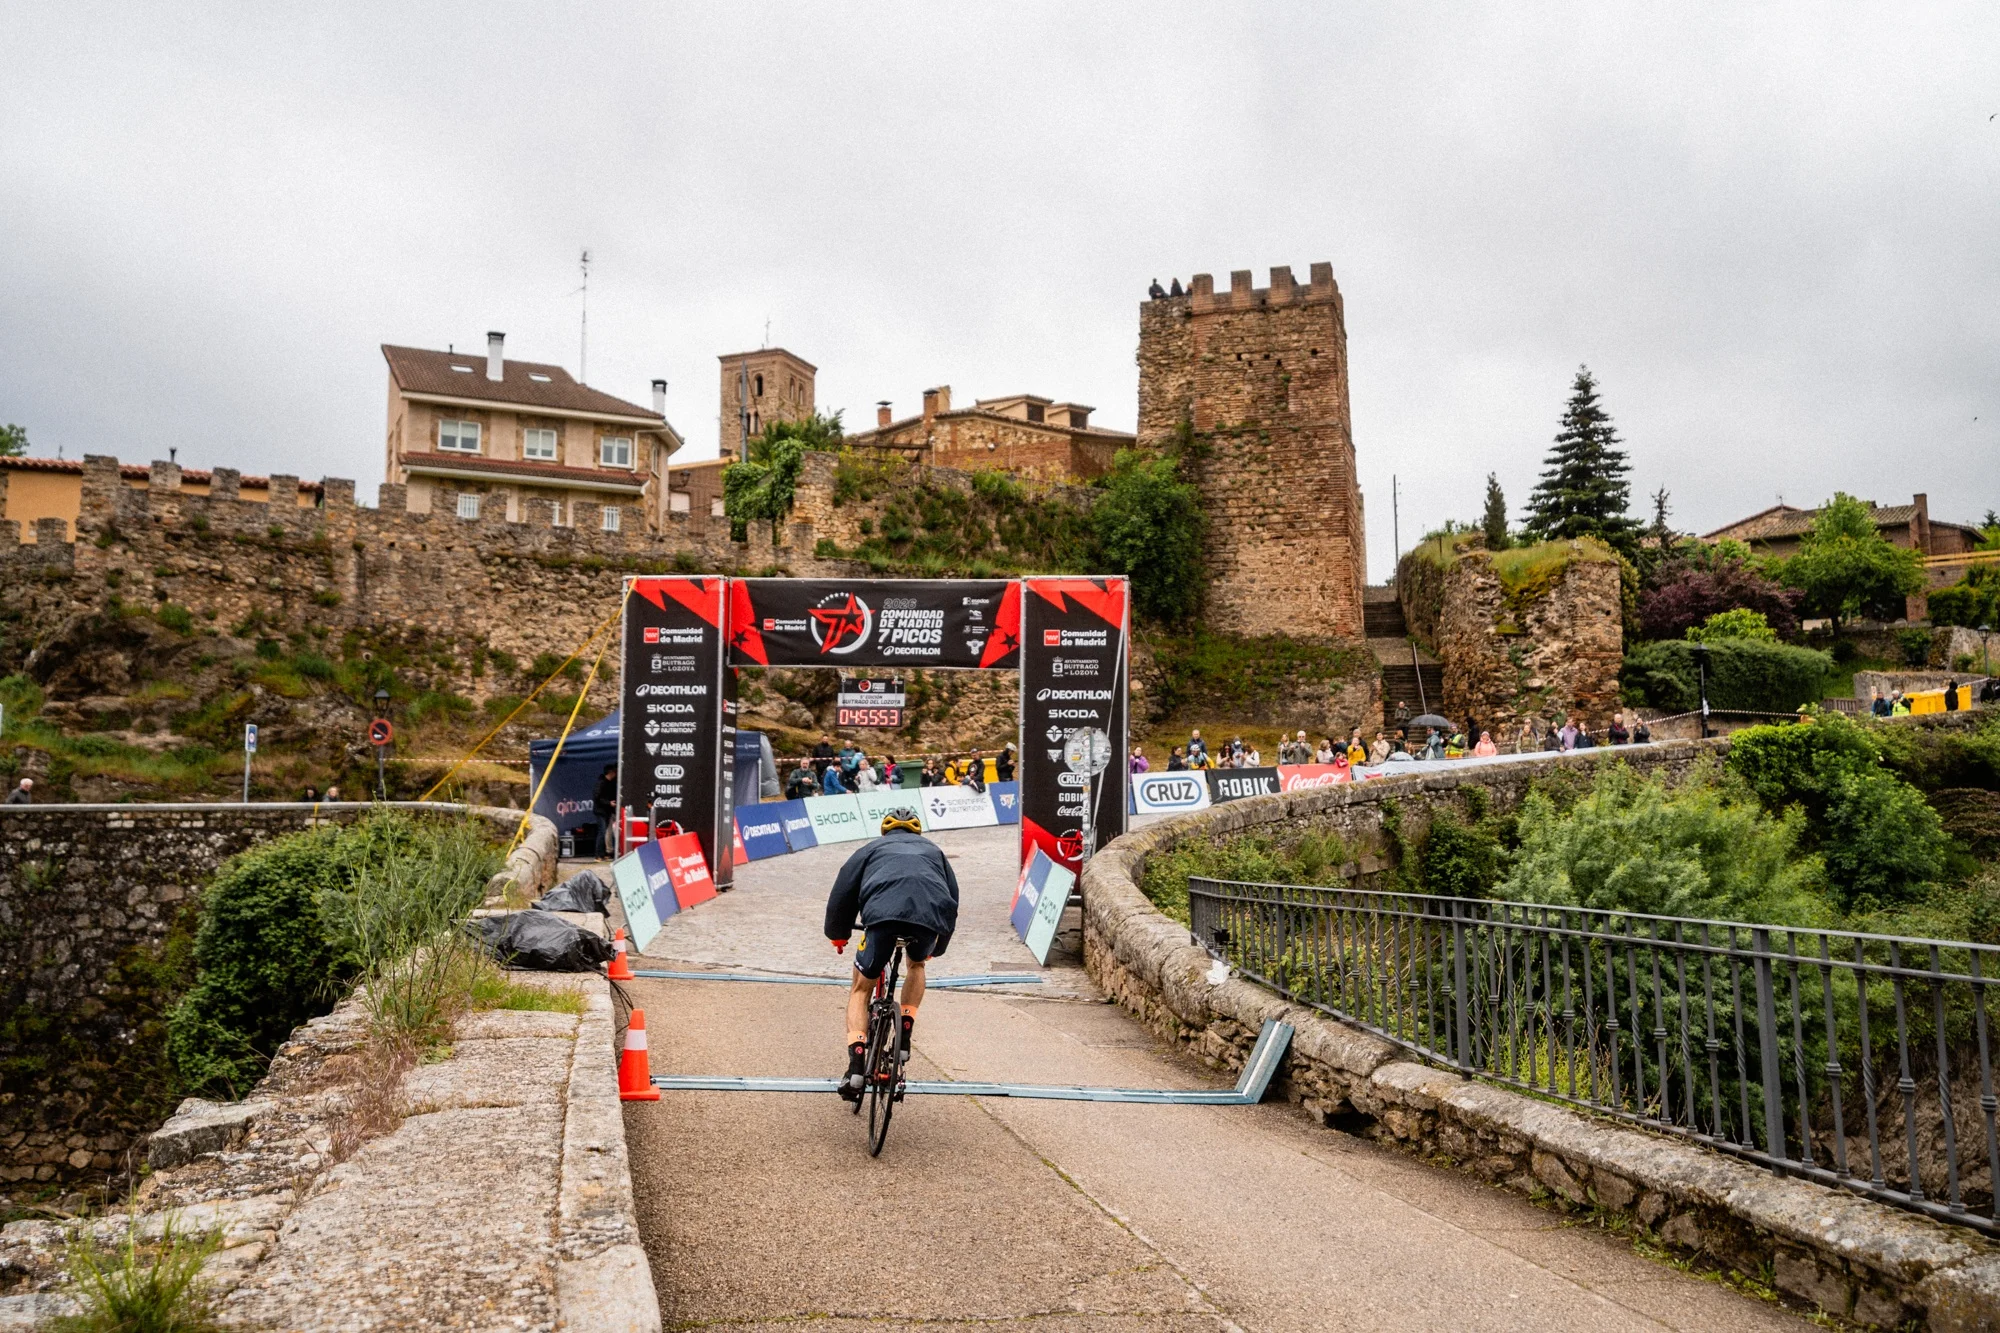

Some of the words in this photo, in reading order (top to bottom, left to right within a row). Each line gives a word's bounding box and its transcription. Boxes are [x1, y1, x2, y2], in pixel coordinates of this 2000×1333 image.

[883, 598, 917, 609] 2026
[881, 610, 944, 619] COMUNIDAD
[879, 619, 895, 628] DE
[898, 619, 943, 628] MADRID
[660, 635, 672, 643] de
[674, 635, 702, 643] Madrid
[878, 629, 890, 643] 7
[891, 629, 942, 644] PICOS
[1061, 638, 1073, 646] de
[1075, 638, 1107, 646] Madrid
[895, 647, 941, 655] DECATHLON
[650, 685, 707, 695] DECATHLON
[1051, 690, 1112, 700] DECATHLON
[661, 743, 694, 751] AMBAR
[658, 767, 681, 776] CRUZ
[1060, 775, 1084, 784] CRUZ
[655, 785, 681, 794] GOBIK
[1218, 777, 1269, 797] GOBIK
[1146, 783, 1195, 801] CRUZ
[750, 822, 781, 837] DECATHLON
